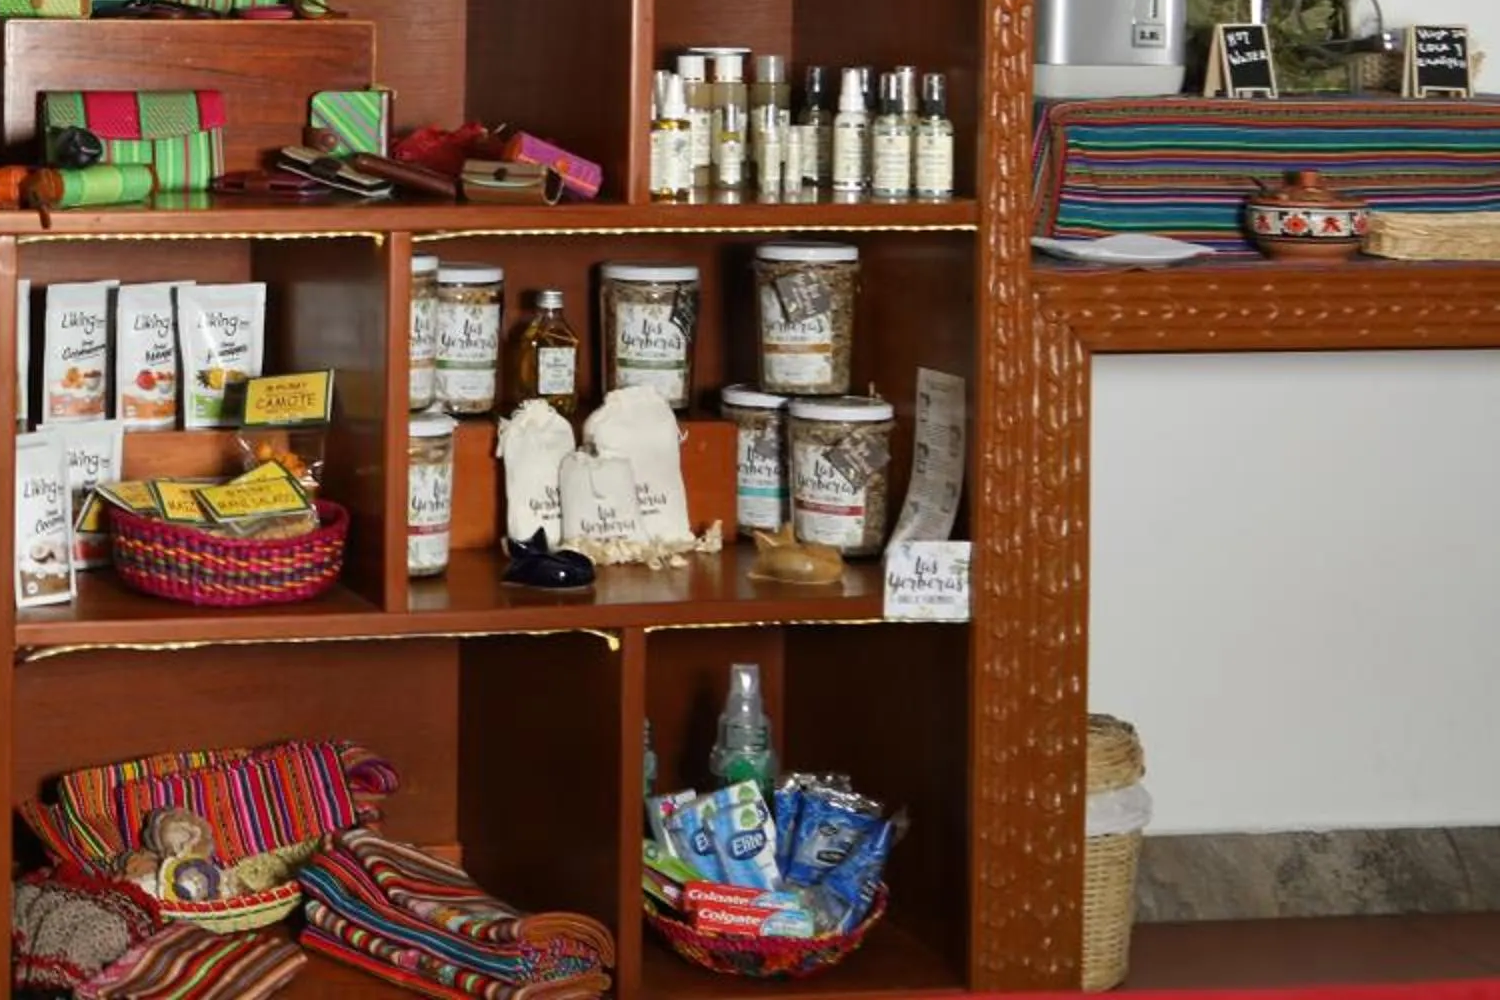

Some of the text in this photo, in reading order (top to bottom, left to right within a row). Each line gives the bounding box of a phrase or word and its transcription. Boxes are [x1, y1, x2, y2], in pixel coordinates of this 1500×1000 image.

[60, 311, 96, 336] Liking
[133, 314, 172, 338] Liking
[66, 448, 99, 475] iking
[698, 907, 763, 927] Colgate
